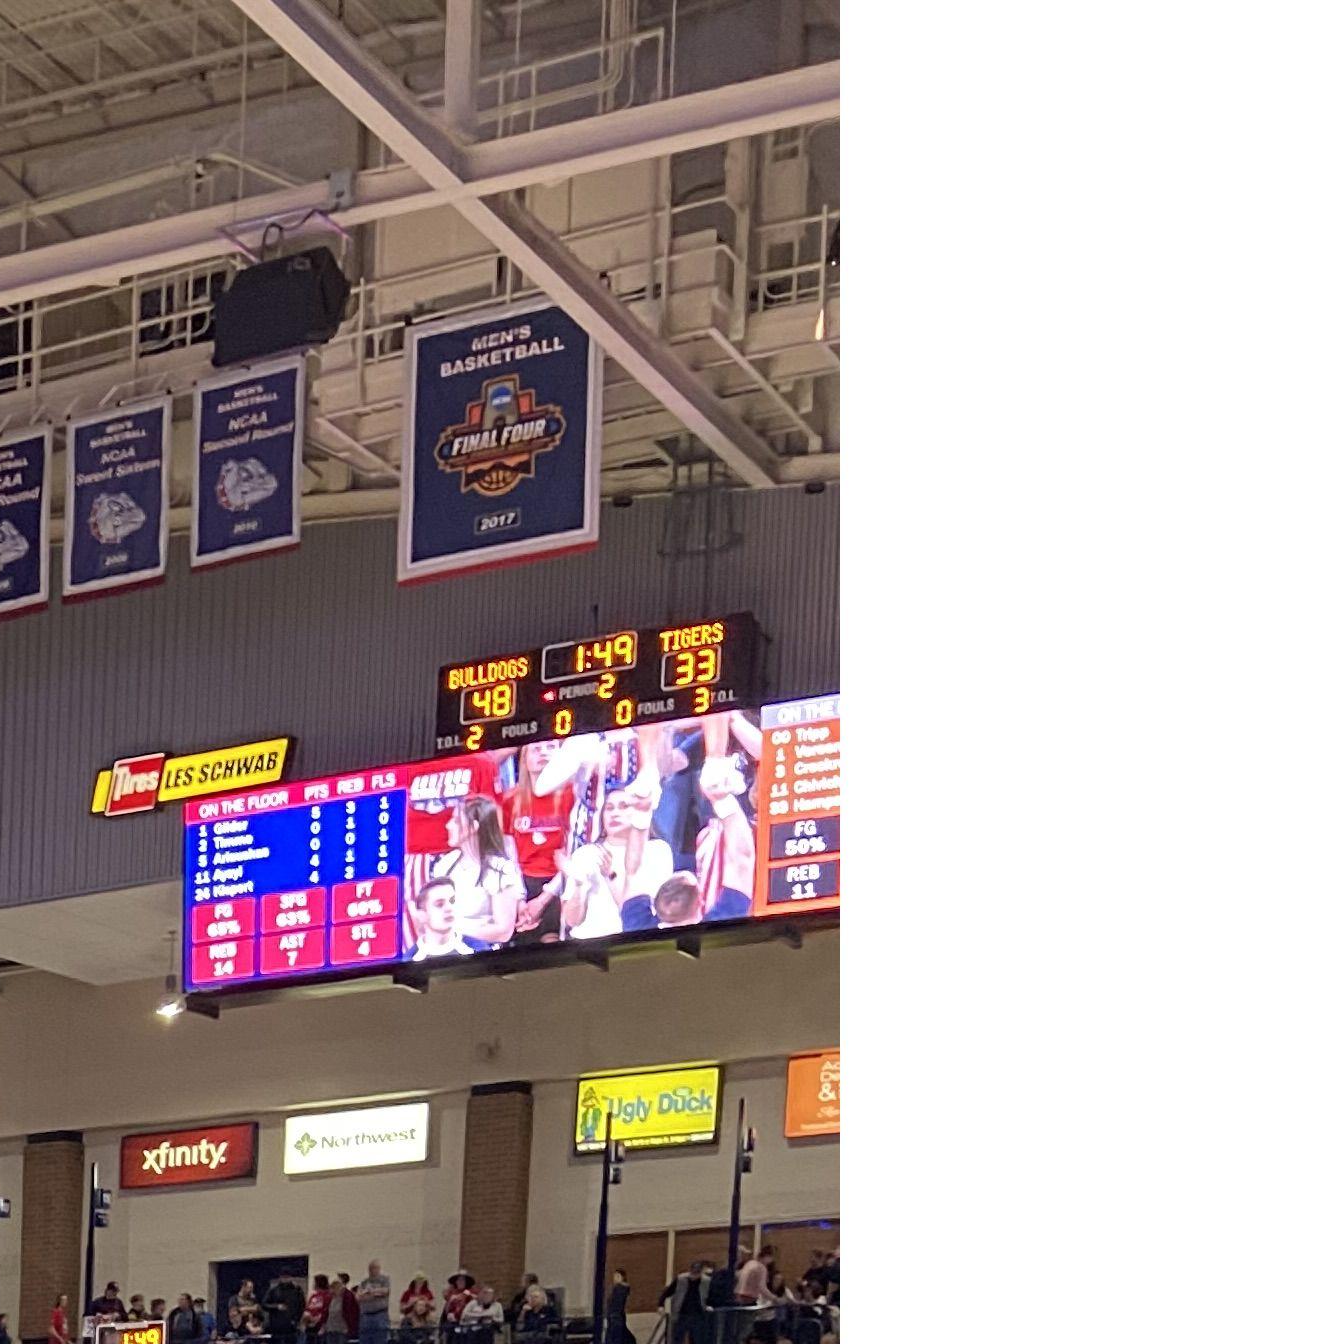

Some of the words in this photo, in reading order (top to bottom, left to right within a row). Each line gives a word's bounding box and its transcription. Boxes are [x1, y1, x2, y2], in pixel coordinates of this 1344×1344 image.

[472, 324, 533, 352] MEN'S
[440, 336, 565, 378] BASKETBALL
[451, 430, 499, 457] FINAL
[500, 418, 547, 446] FOUR
[479, 512, 516, 532] 2017
[659, 622, 724, 653] TIGERS
[575, 634, 634, 674] 1:49
[675, 648, 717, 685] 33
[448, 656, 529, 690] BULLDOGS
[597, 673, 616, 699] 2
[472, 683, 512, 717] 48
[615, 699, 633, 726] 0
[637, 698, 675, 716] FOULS
[694, 687, 710, 714] 3
[777, 706, 802, 725] ON
[805, 700, 835, 720] THE
[502, 721, 538, 739] FOULS
[554, 709, 572, 735] 0
[465, 725, 484, 750] 2
[112, 764, 160, 802] Tires
[165, 766, 193, 789] LES
[198, 751, 279, 784] SCHWAB
[199, 803, 219, 819] ON
[221, 798, 246, 815] THE
[247, 791, 290, 810] FLOOR
[303, 784, 330, 801] PTS
[336, 777, 365, 794] REB
[371, 773, 396, 789] FLS
[794, 820, 817, 837] FG
[786, 863, 822, 883] REB
[355, 882, 373, 897] FT
[790, 882, 818, 900] 11
[279, 932, 307, 950] AST
[351, 923, 378, 941] STL
[286, 951, 298, 966] 7
[357, 941, 370, 956] 4
[214, 961, 234, 977] 14
[603, 1094, 652, 1125] Ugly
[656, 1088, 713, 1115] Duck
[320, 1127, 416, 1150] Northwest
